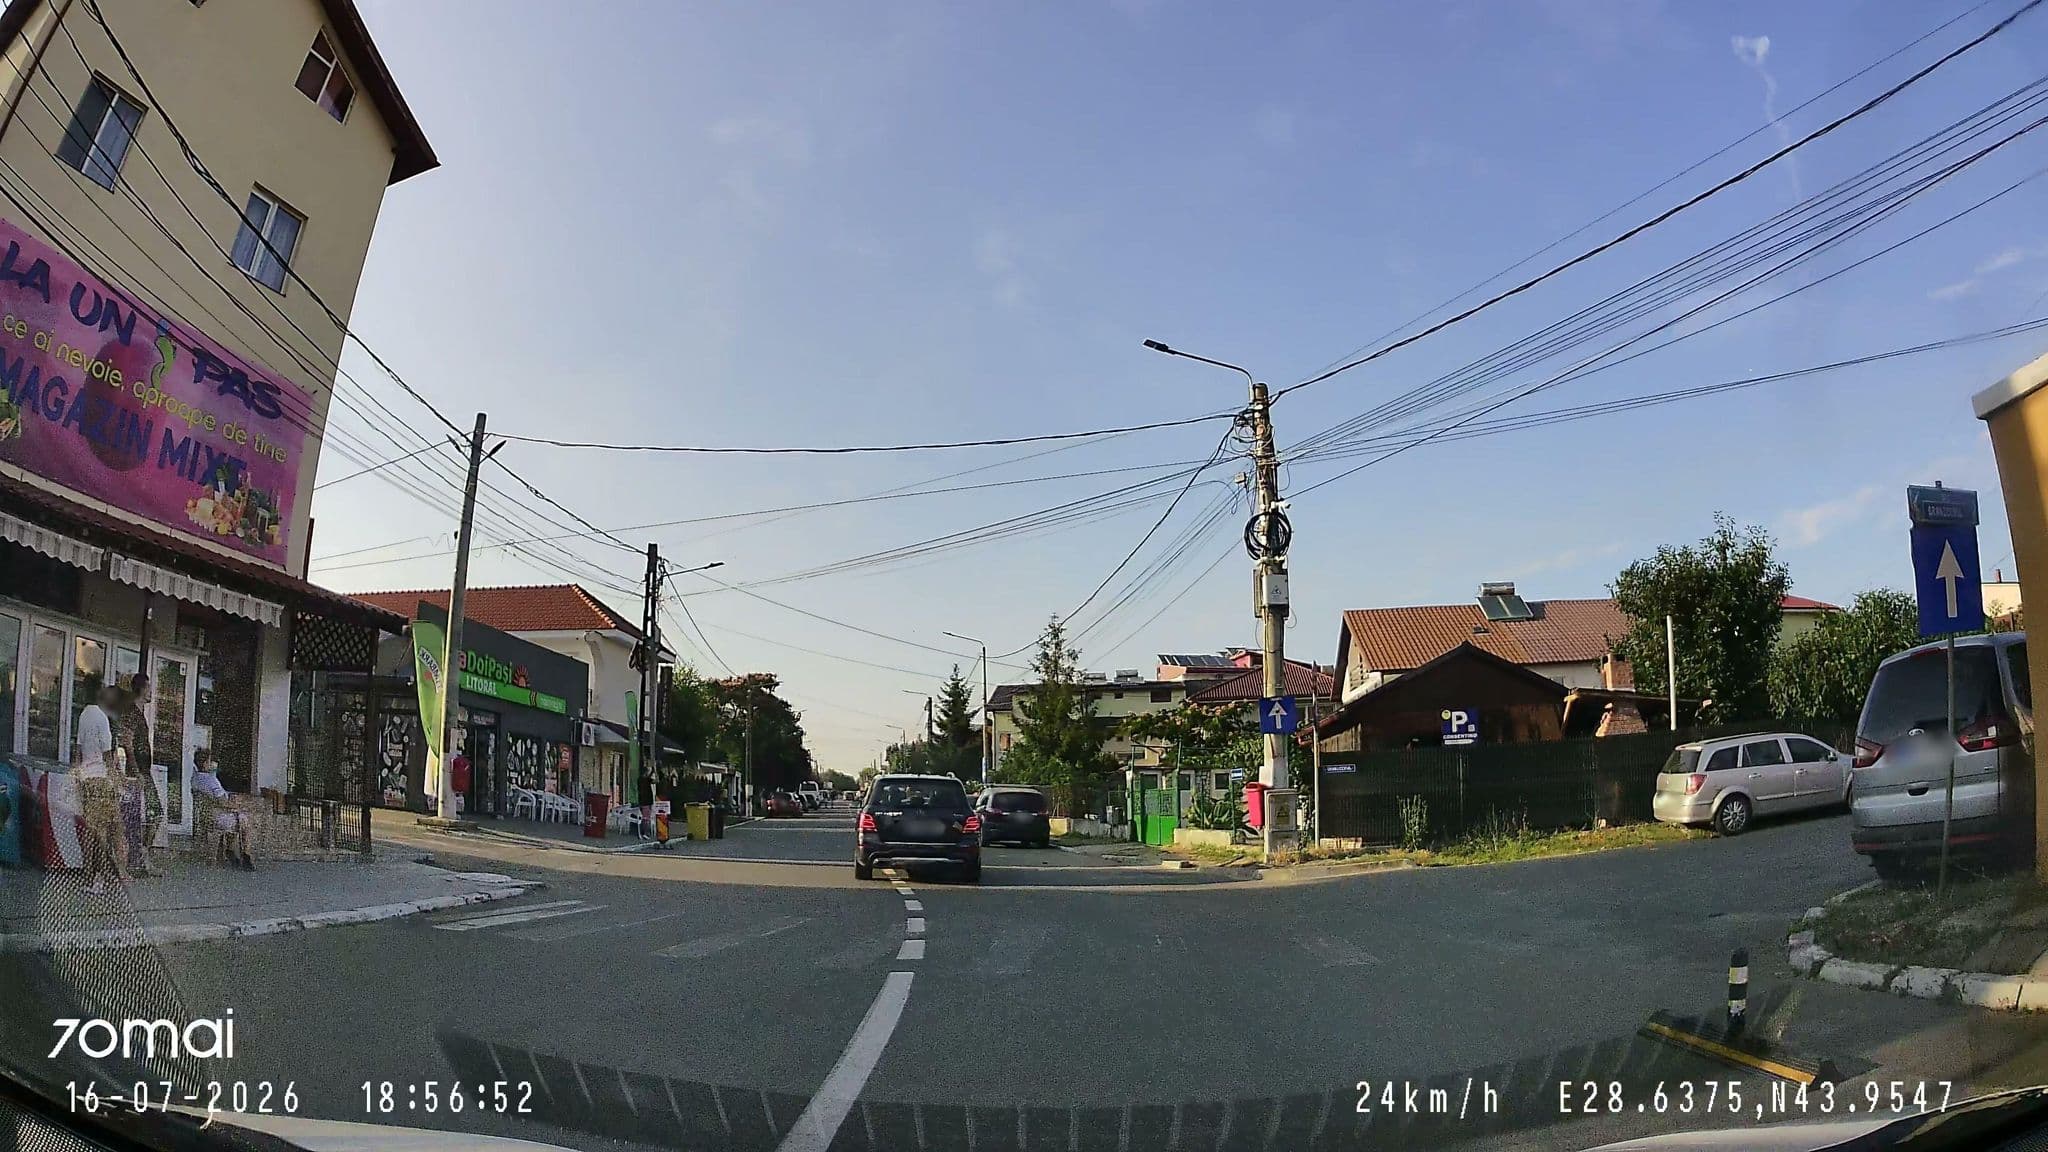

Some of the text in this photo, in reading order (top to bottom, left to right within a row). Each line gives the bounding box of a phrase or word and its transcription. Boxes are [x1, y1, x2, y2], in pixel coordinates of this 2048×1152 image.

[0, 241, 282, 419] LA UN PAS
[3, 315, 287, 463] ce ai nevoie, aproape de tine
[0, 346, 247, 497] MAGAZIN MIXT
[466, 674, 497, 696] LITORAL
[1452, 711, 1468, 733] P
